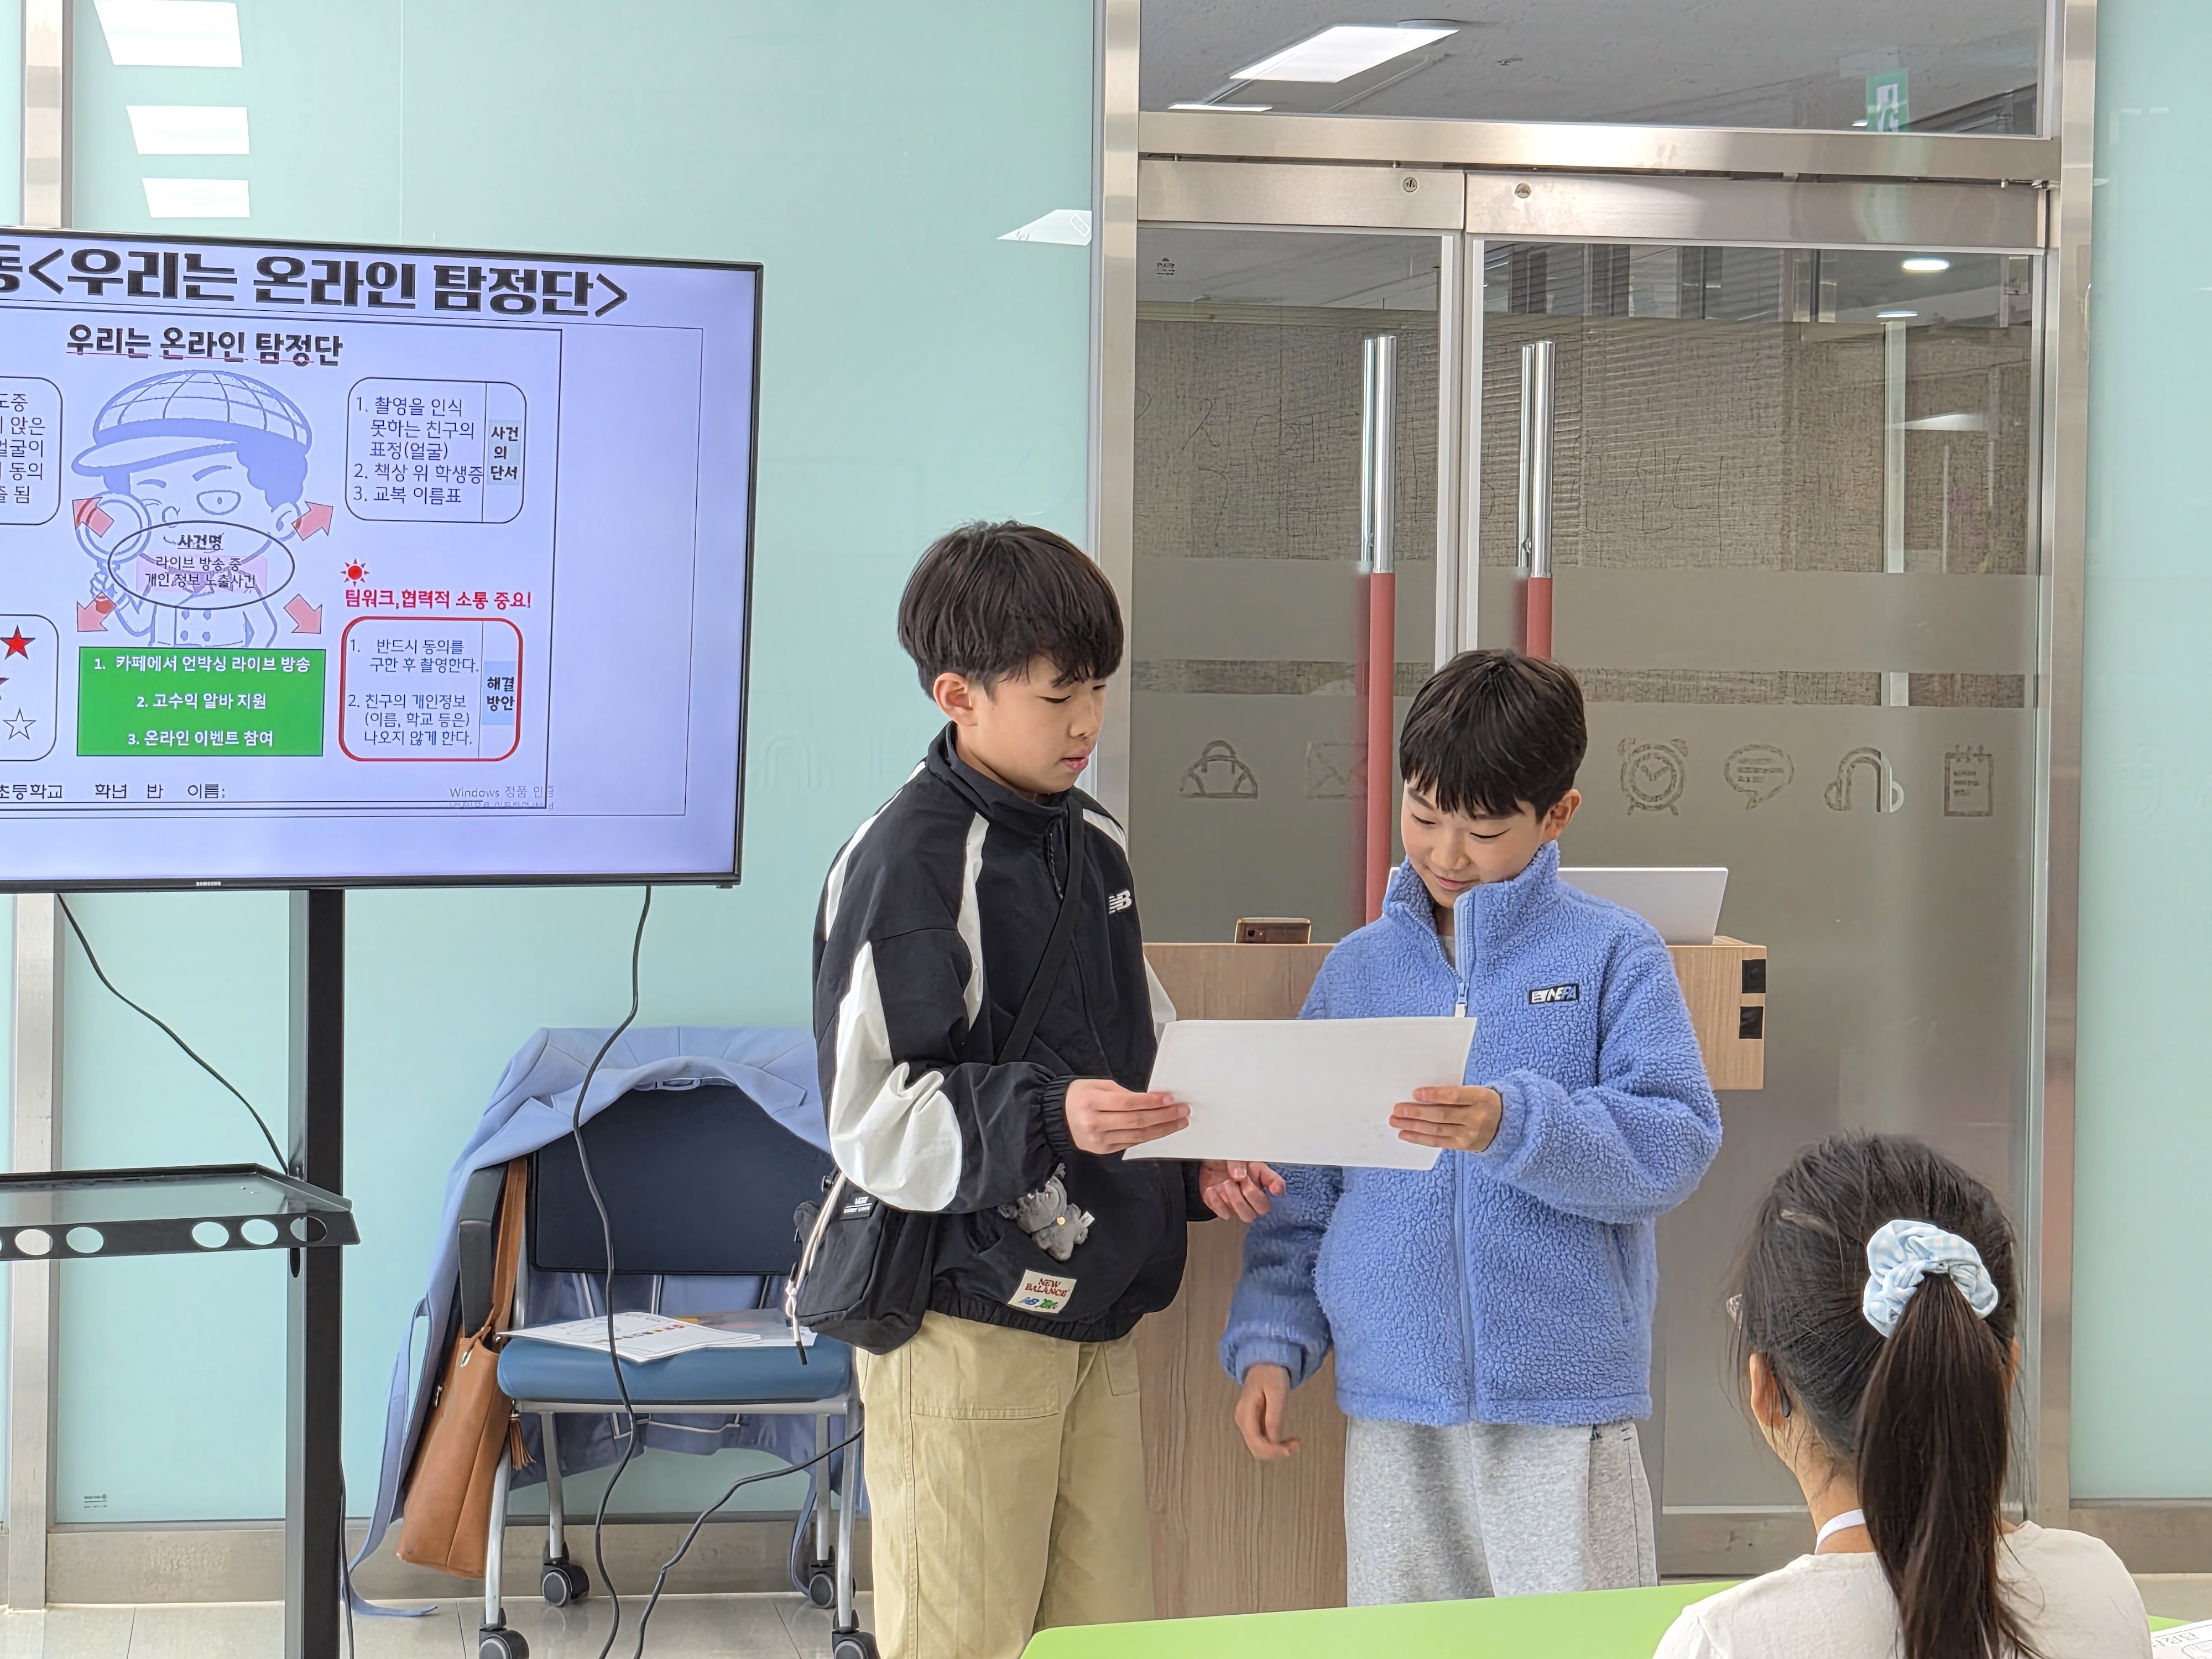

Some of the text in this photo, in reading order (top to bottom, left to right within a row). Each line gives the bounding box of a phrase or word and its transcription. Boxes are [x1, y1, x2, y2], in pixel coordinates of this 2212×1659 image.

[253, 255, 416, 309] 온라인
[67, 324, 343, 366] 우리는 온라인 탐정단
[356, 396, 463, 417] 1. 촬영을 인식
[371, 419, 474, 440] 못하는 친구의
[491, 426, 519, 442] 사건
[369, 441, 448, 461] 표정(얼굴)
[494, 445, 508, 460] 의
[354, 463, 484, 484] 2. 책상 위 학생증
[491, 465, 518, 481] 단서
[353, 486, 462, 505] 3. 교복 이름표
[178, 534, 222, 551] 사건명
[156, 556, 242, 572] 라이브 방송 중
[145, 573, 169, 587] 개인
[175, 574, 200, 588] 정보
[456, 591, 488, 609] 소통
[494, 591, 531, 610] 중요!
[350, 639, 464, 655] 1. 반드시 동의를
[95, 655, 311, 673] 1. 카페에서 언박싱 라이브 방송
[370, 658, 479, 674] 구한 후 촬영한다.
[487, 676, 515, 692] 해결
[137, 693, 267, 710] 2. 고수익 알바 지원
[348, 693, 466, 709] 2. 친구의 개인정보
[487, 695, 515, 712] 방안
[364, 712, 470, 728] (이름, 학교 등은)
[128, 731, 273, 747] 3. 온라인 이벤트 참여
[364, 730, 472, 746] 나오지 않게 한다.
[95, 784, 127, 800] 학년
[147, 784, 164, 800] 반
[187, 784, 226, 800] 이름:
[450, 787, 500, 797] Windows
[505, 785, 528, 798] 정품
[1547, 985, 1576, 1001] NEPA
[1025, 1283, 1068, 1297] BALANCE
[1039, 1278, 1061, 1287] NEW
